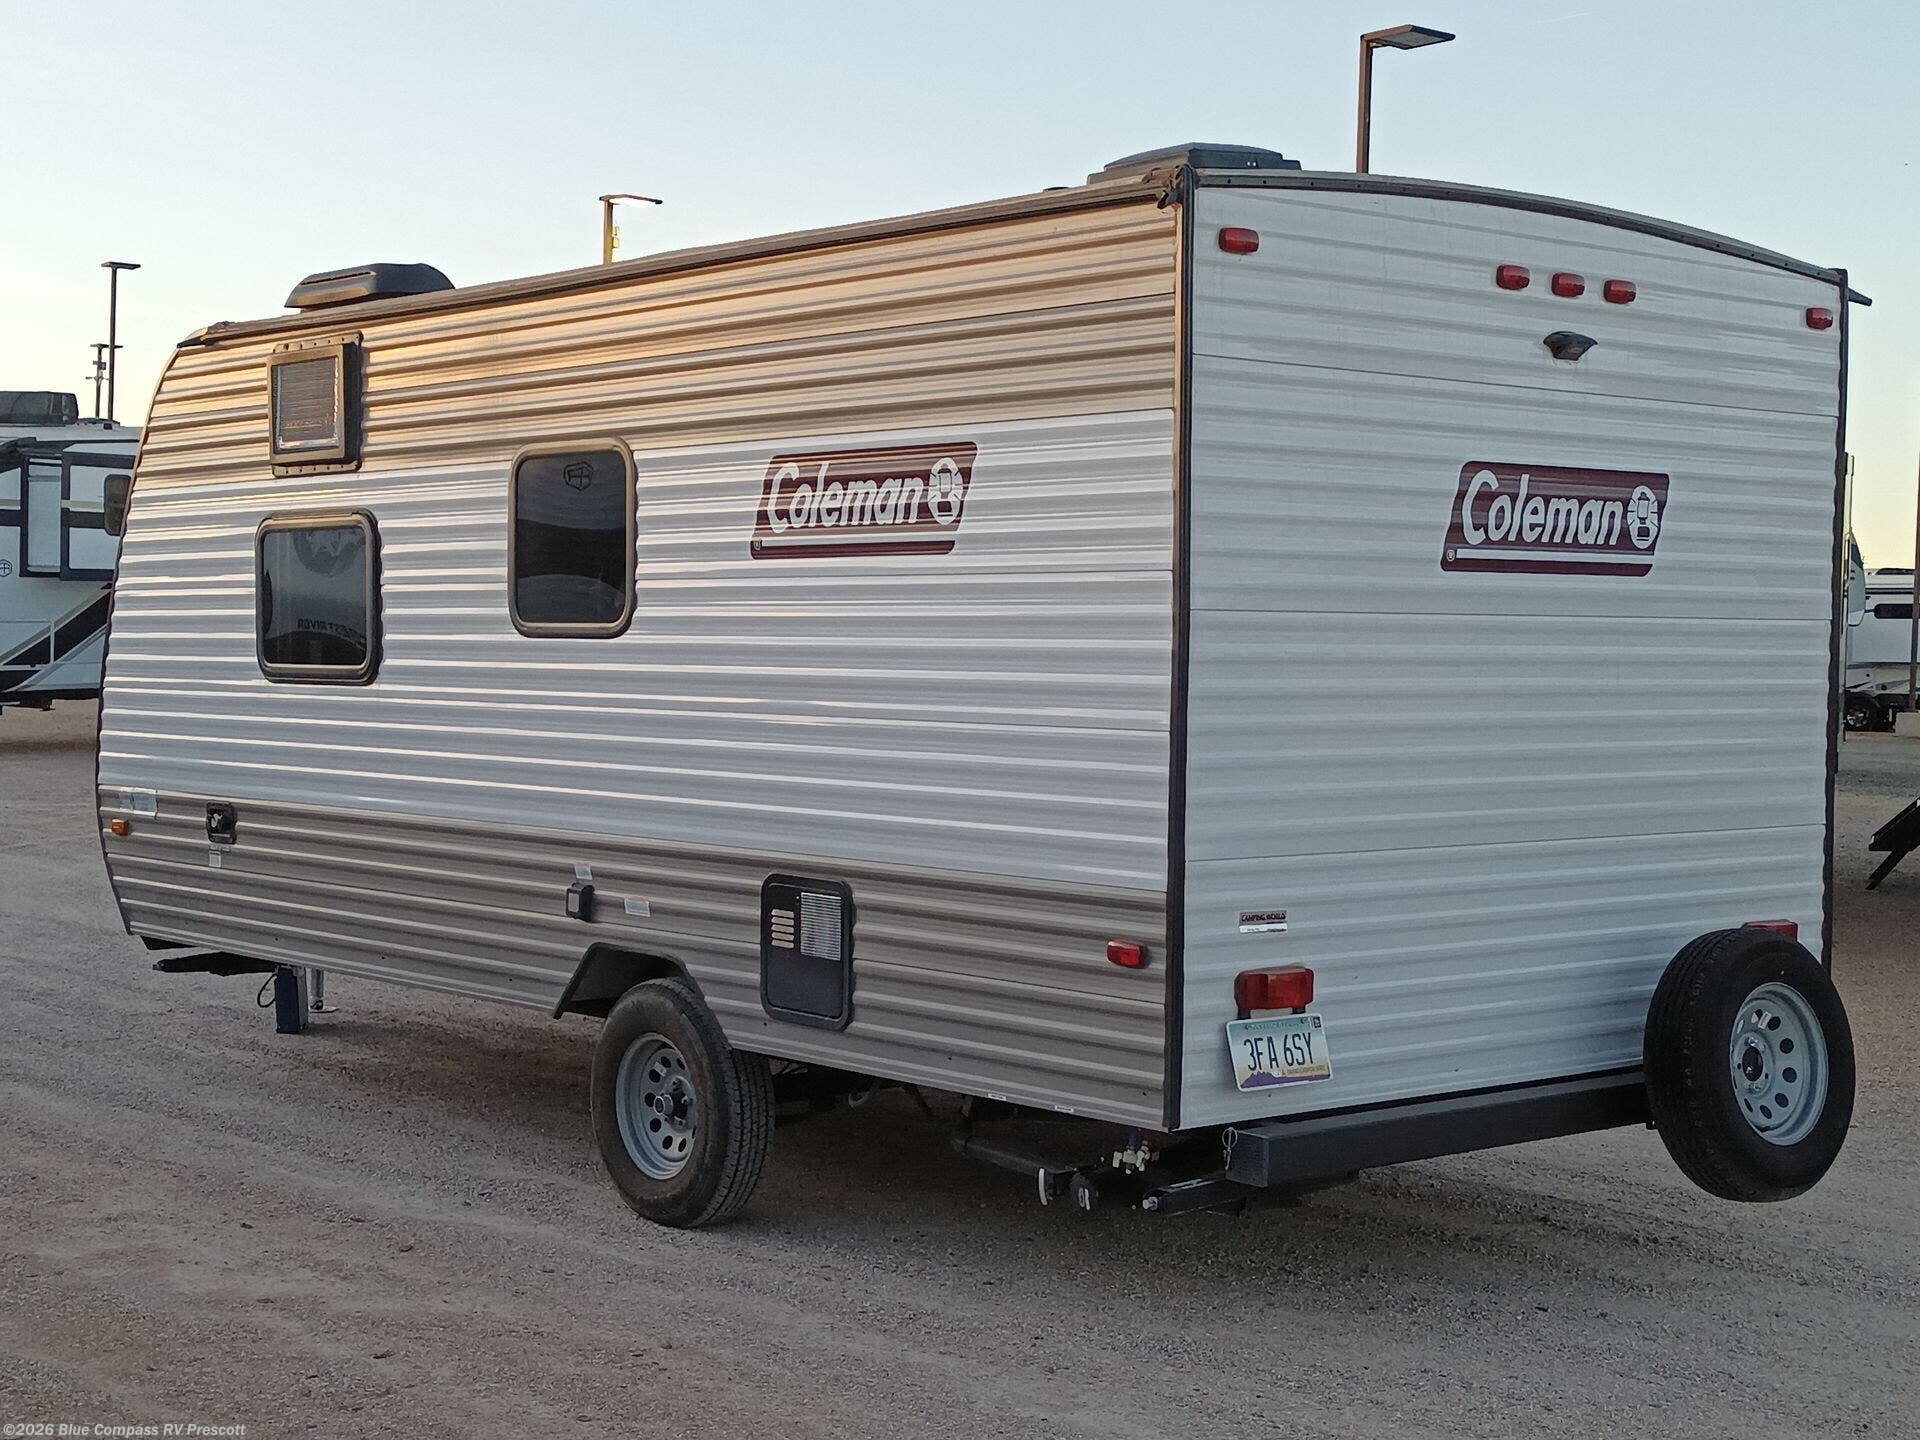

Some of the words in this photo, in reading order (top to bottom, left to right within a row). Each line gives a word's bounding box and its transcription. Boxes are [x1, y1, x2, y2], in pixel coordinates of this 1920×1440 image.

[767, 461, 924, 534] Coleman
[1461, 469, 1624, 546] Coleman
[1243, 1035, 1280, 1072] 3FA
[1283, 1031, 1314, 1067] 6SY
